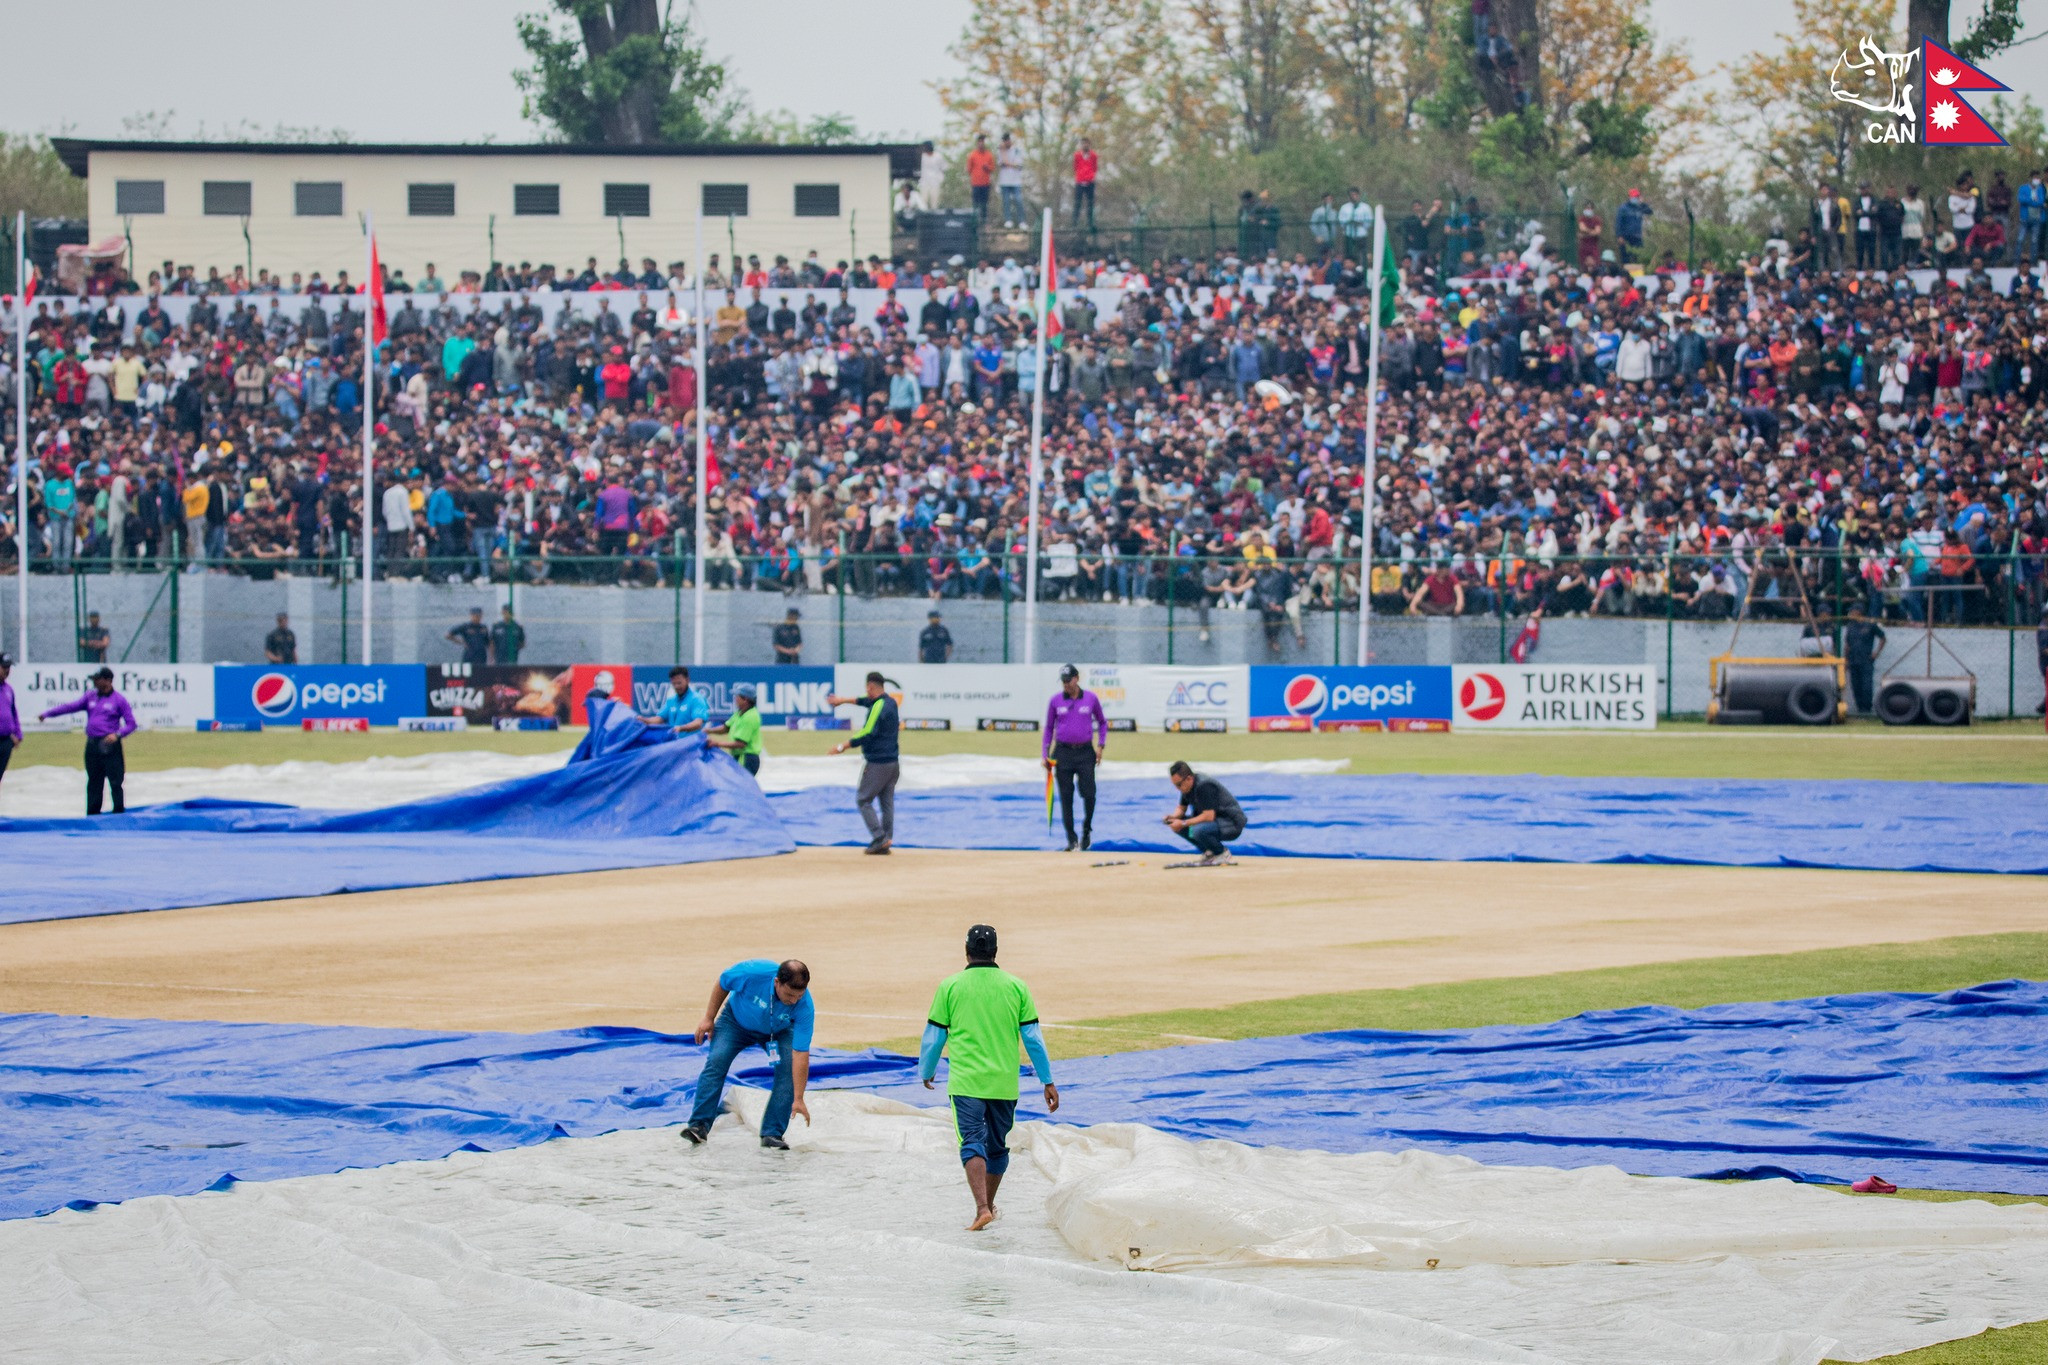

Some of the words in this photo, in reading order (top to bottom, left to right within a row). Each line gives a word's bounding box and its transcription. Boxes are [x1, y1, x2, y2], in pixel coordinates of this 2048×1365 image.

[121, 671, 188, 693] Fresh
[1521, 673, 1644, 694] TURKISH
[302, 677, 387, 710] pepsi
[429, 686, 485, 711] CHIZZA
[912, 691, 937, 701] THE
[939, 691, 960, 701] IPG
[963, 692, 1010, 701] GROUP
[1167, 681, 1228, 706] ACC
[1332, 680, 1416, 711] pepsi
[1520, 701, 1645, 721] AIRLINES
[327, 719, 360, 731] KFC
